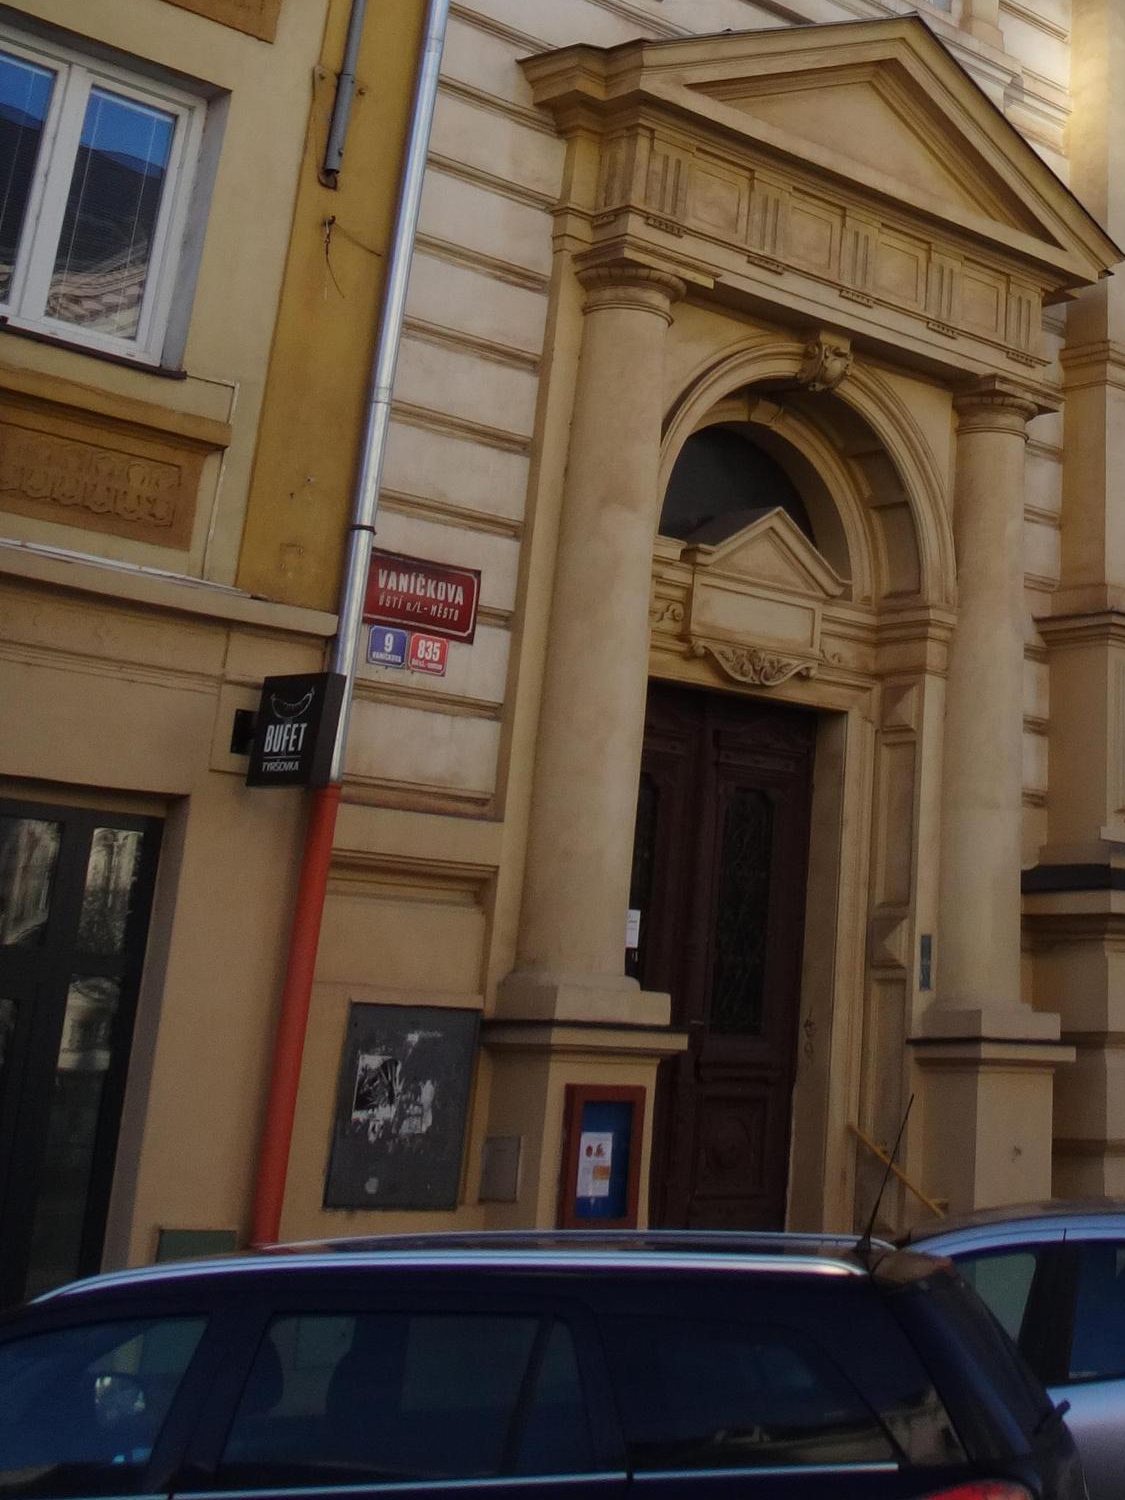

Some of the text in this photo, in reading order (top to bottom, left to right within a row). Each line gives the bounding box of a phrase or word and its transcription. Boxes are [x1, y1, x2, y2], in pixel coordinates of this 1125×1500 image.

[378, 569, 464, 605] VANÍČKOVA
[378, 591, 404, 609] ÚSTÍ
[384, 632, 395, 653] 9
[417, 639, 441, 661] 835
[263, 723, 308, 753] BUFET
